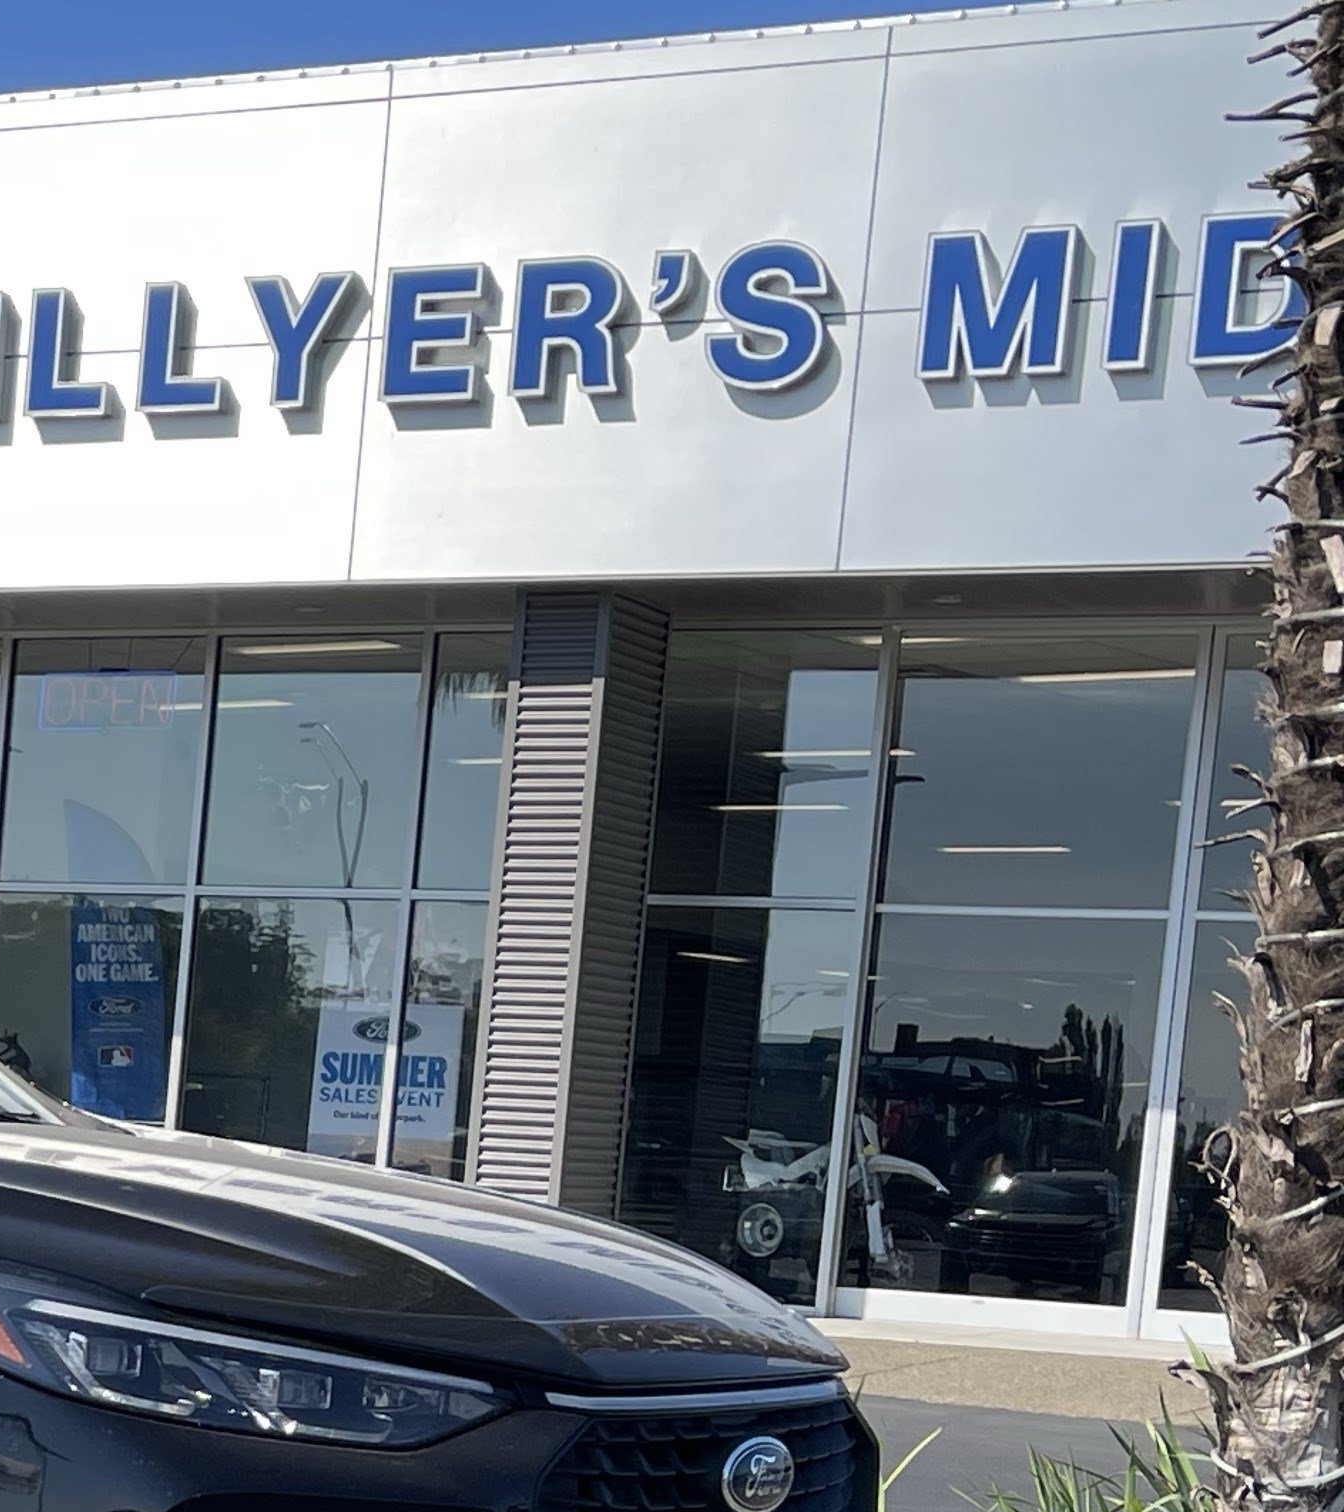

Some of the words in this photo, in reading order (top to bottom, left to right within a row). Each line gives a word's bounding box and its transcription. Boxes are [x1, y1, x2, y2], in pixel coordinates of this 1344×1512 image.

[916, 210, 1308, 380] MID
[45, 677, 173, 726] OPEN
[77, 923, 155, 943] AMERICAN
[75, 963, 108, 982] ONE
[109, 963, 159, 982] GAME.
[319, 1087, 378, 1105] SALES
[396, 1090, 445, 1108] VENT
